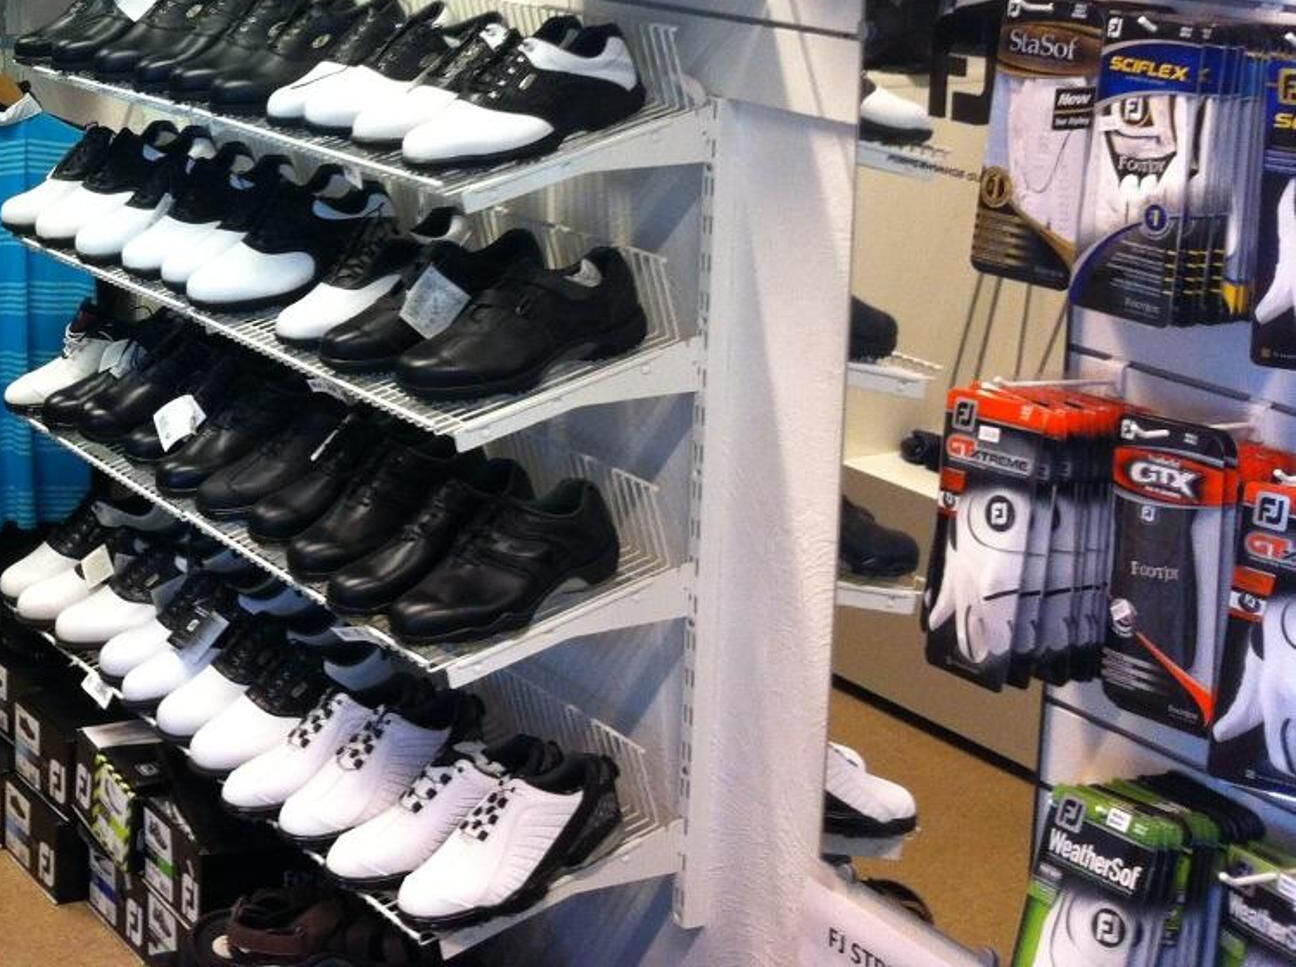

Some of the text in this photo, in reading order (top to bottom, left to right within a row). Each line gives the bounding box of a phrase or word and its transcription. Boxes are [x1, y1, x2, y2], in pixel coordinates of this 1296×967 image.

[1009, 29, 1079, 61] StaSof
[1109, 55, 1191, 81] SCIFLEX
[954, 401, 976, 427] FJ
[1130, 460, 1198, 500] GTX
[1259, 496, 1285, 525] FJ
[1059, 800, 1084, 830] FJ
[1049, 828, 1143, 891] WeatherSof
[1228, 890, 1296, 951] WeatherS
[829, 927, 892, 967] FJ STR
